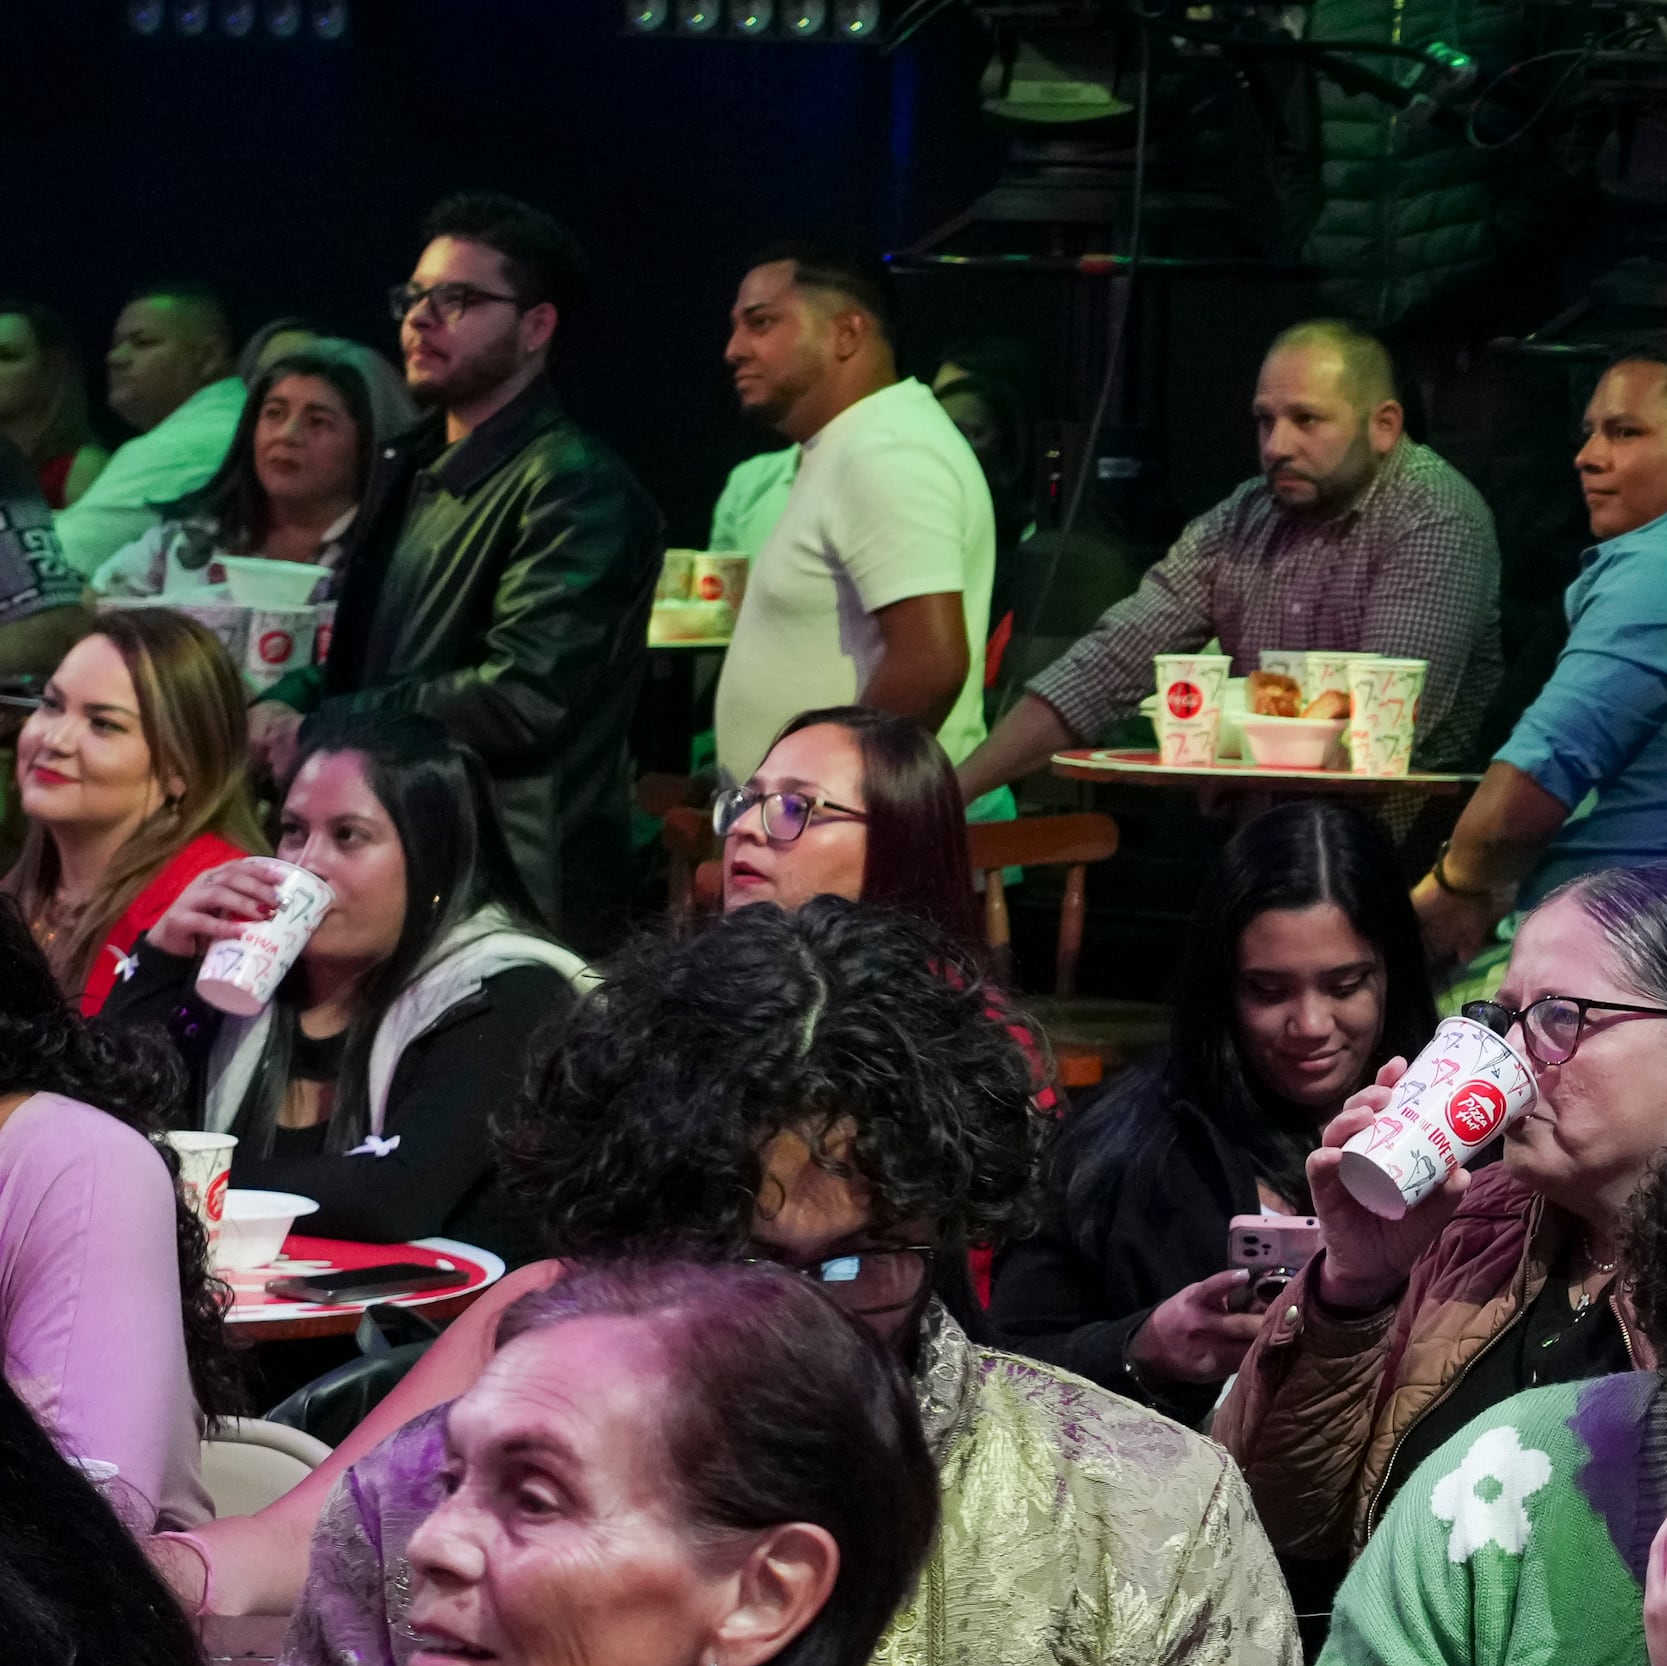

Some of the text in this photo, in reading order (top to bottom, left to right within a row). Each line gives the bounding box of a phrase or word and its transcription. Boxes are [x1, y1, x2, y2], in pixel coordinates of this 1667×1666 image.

[1455, 1110, 1481, 1131] Hut
[1457, 1096, 1488, 1128] Pizza
[1401, 1106, 1420, 1123] FOR
[1428, 1127, 1452, 1159] LOVE
